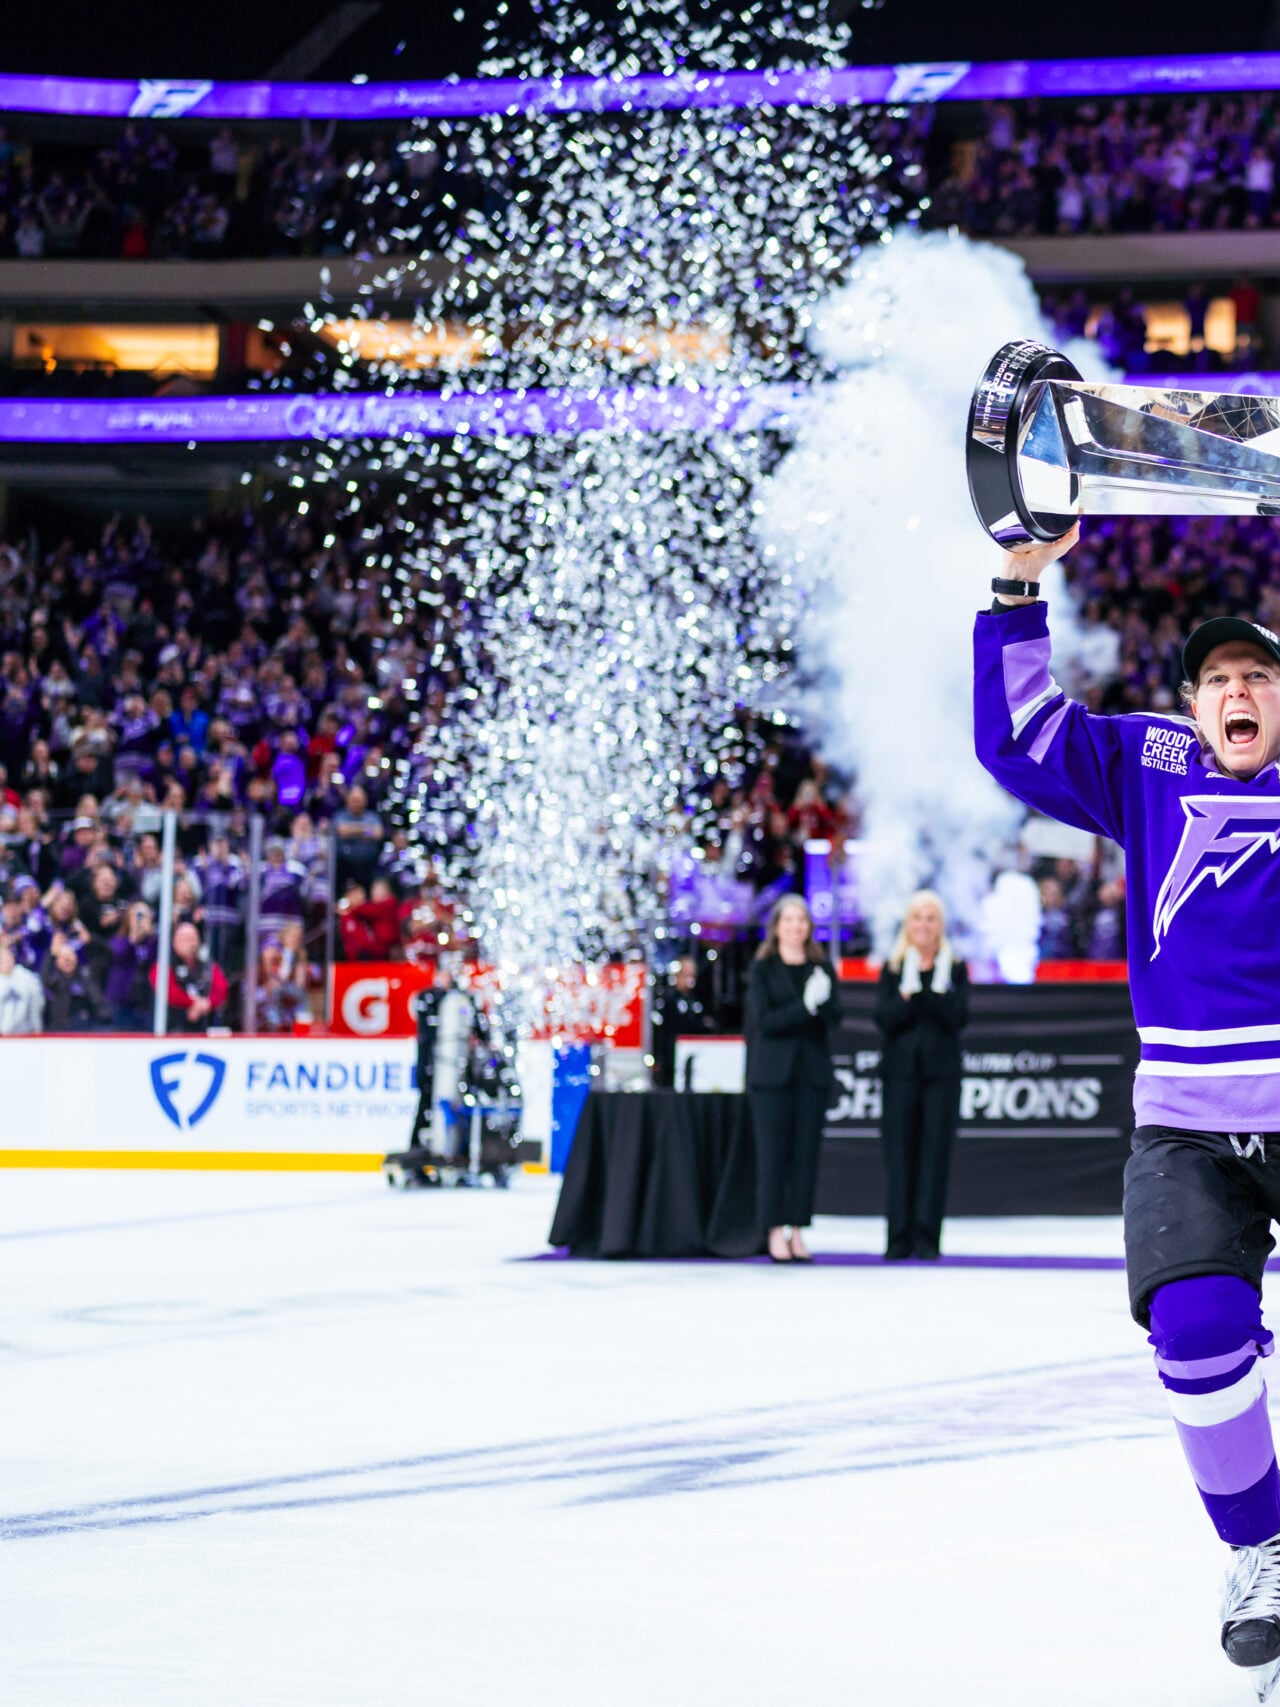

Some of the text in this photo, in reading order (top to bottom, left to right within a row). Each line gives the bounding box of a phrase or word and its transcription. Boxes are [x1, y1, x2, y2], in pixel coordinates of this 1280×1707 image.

[1145, 725, 1196, 750] WOODY
[1142, 742, 1189, 765] CREEK
[1141, 755, 1188, 776] DISTILLERS
[328, 1102, 416, 1120] NETWOR
